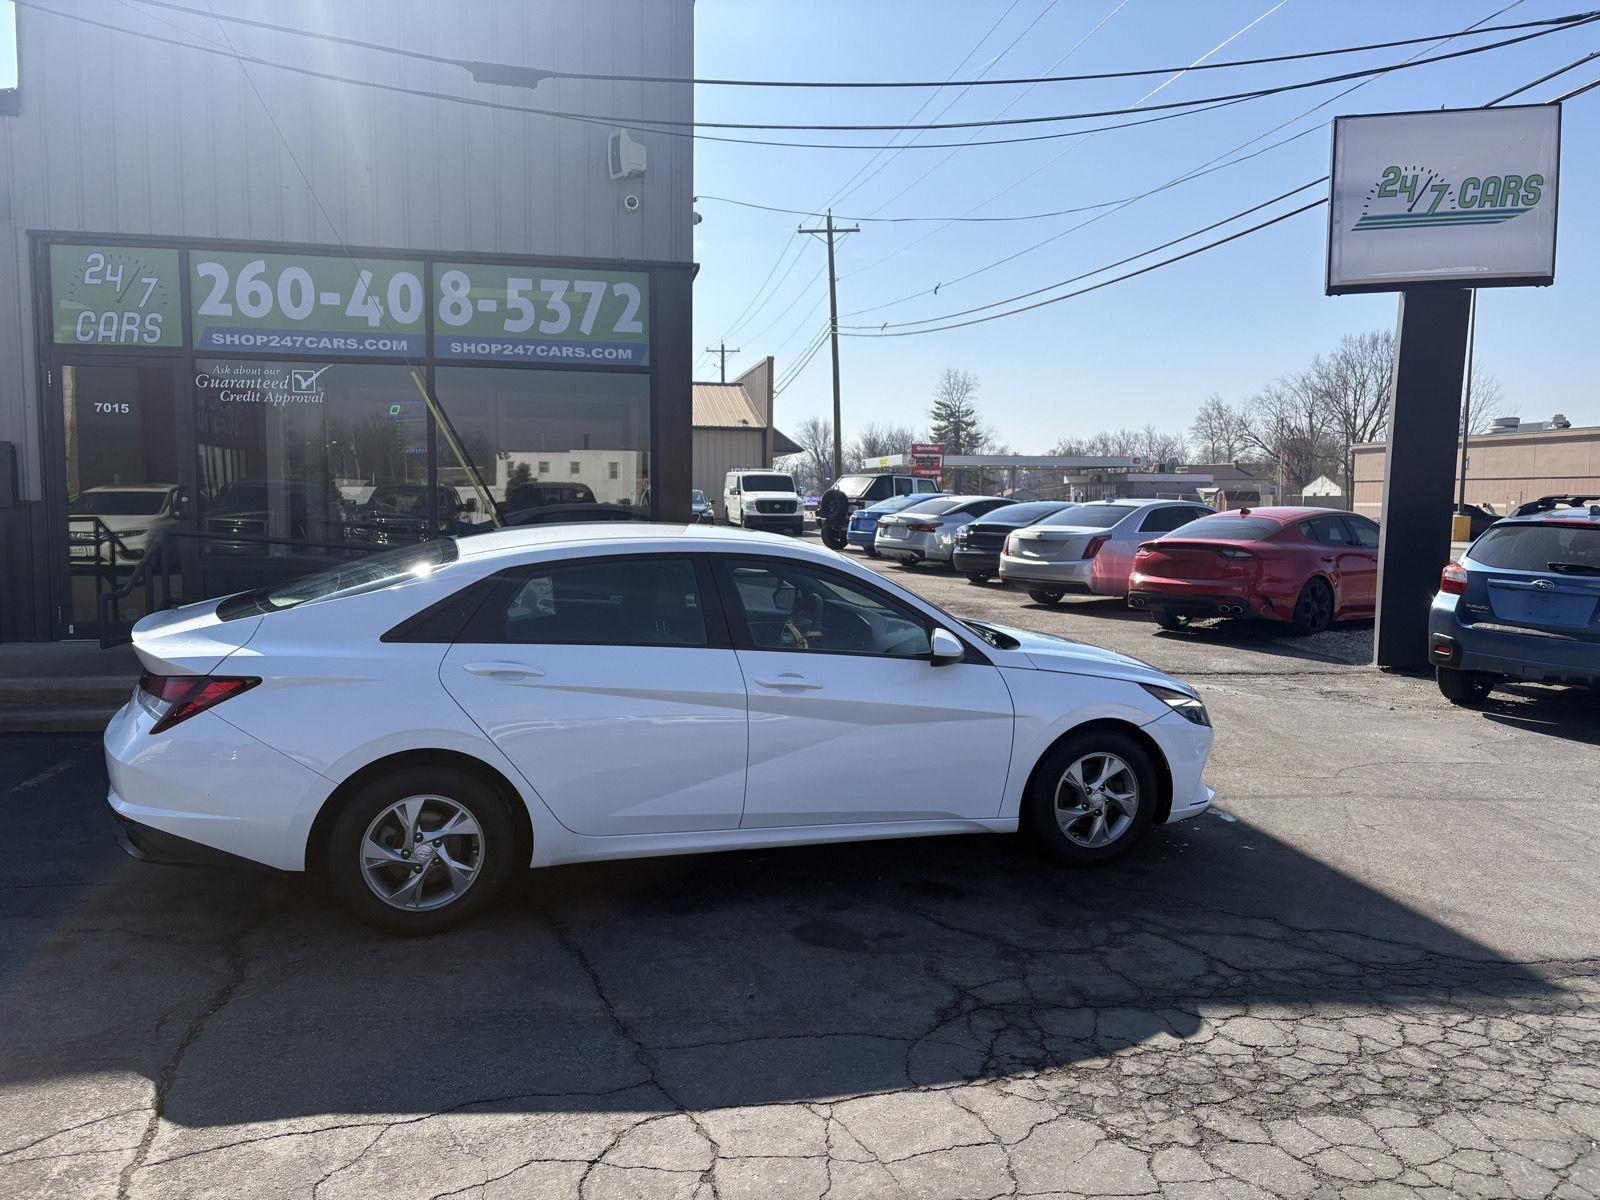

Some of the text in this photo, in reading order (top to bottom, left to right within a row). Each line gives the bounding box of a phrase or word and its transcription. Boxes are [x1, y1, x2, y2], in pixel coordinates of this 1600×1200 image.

[1458, 175, 1544, 208] CARS
[76, 310, 163, 342] CARS
[212, 334, 408, 351] SHOP247CARS.COM
[450, 342, 632, 360] SHOP247CARS.COM
[213, 365, 281, 375] Ask about our
[195, 374, 290, 389] Guaranteed
[220, 390, 324, 406] Credit Approval
[94, 403, 130, 413] 7015
